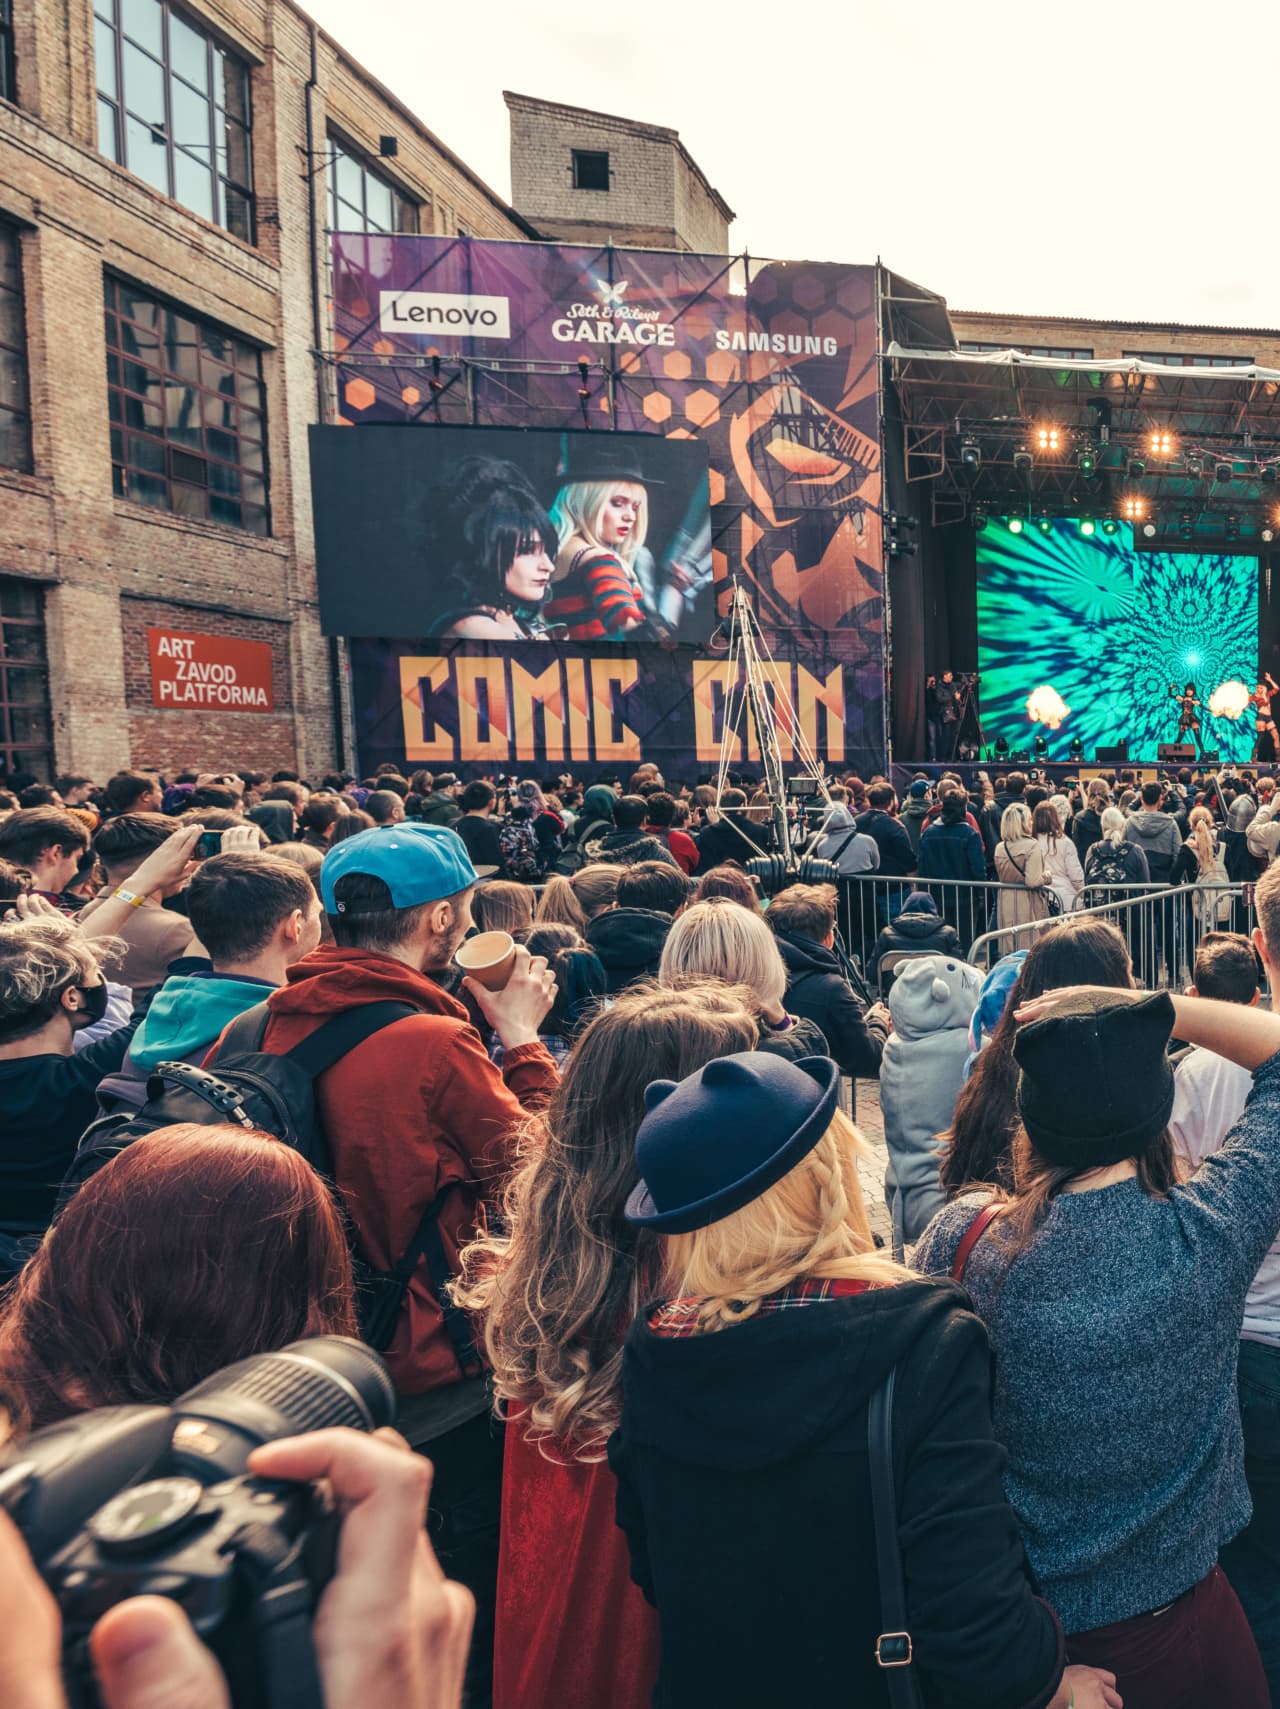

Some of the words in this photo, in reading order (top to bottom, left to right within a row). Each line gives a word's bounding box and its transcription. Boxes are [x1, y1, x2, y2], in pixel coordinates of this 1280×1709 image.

[392, 300, 498, 326] Lenovo
[551, 318, 676, 346] GARAGE
[715, 329, 838, 357] SAMSUNG
[158, 636, 195, 659] ART
[175, 661, 237, 683] ZAVOD
[159, 680, 268, 706] PLATFORMA
[398, 655, 642, 762] COMIC
[692, 659, 846, 762] CON
